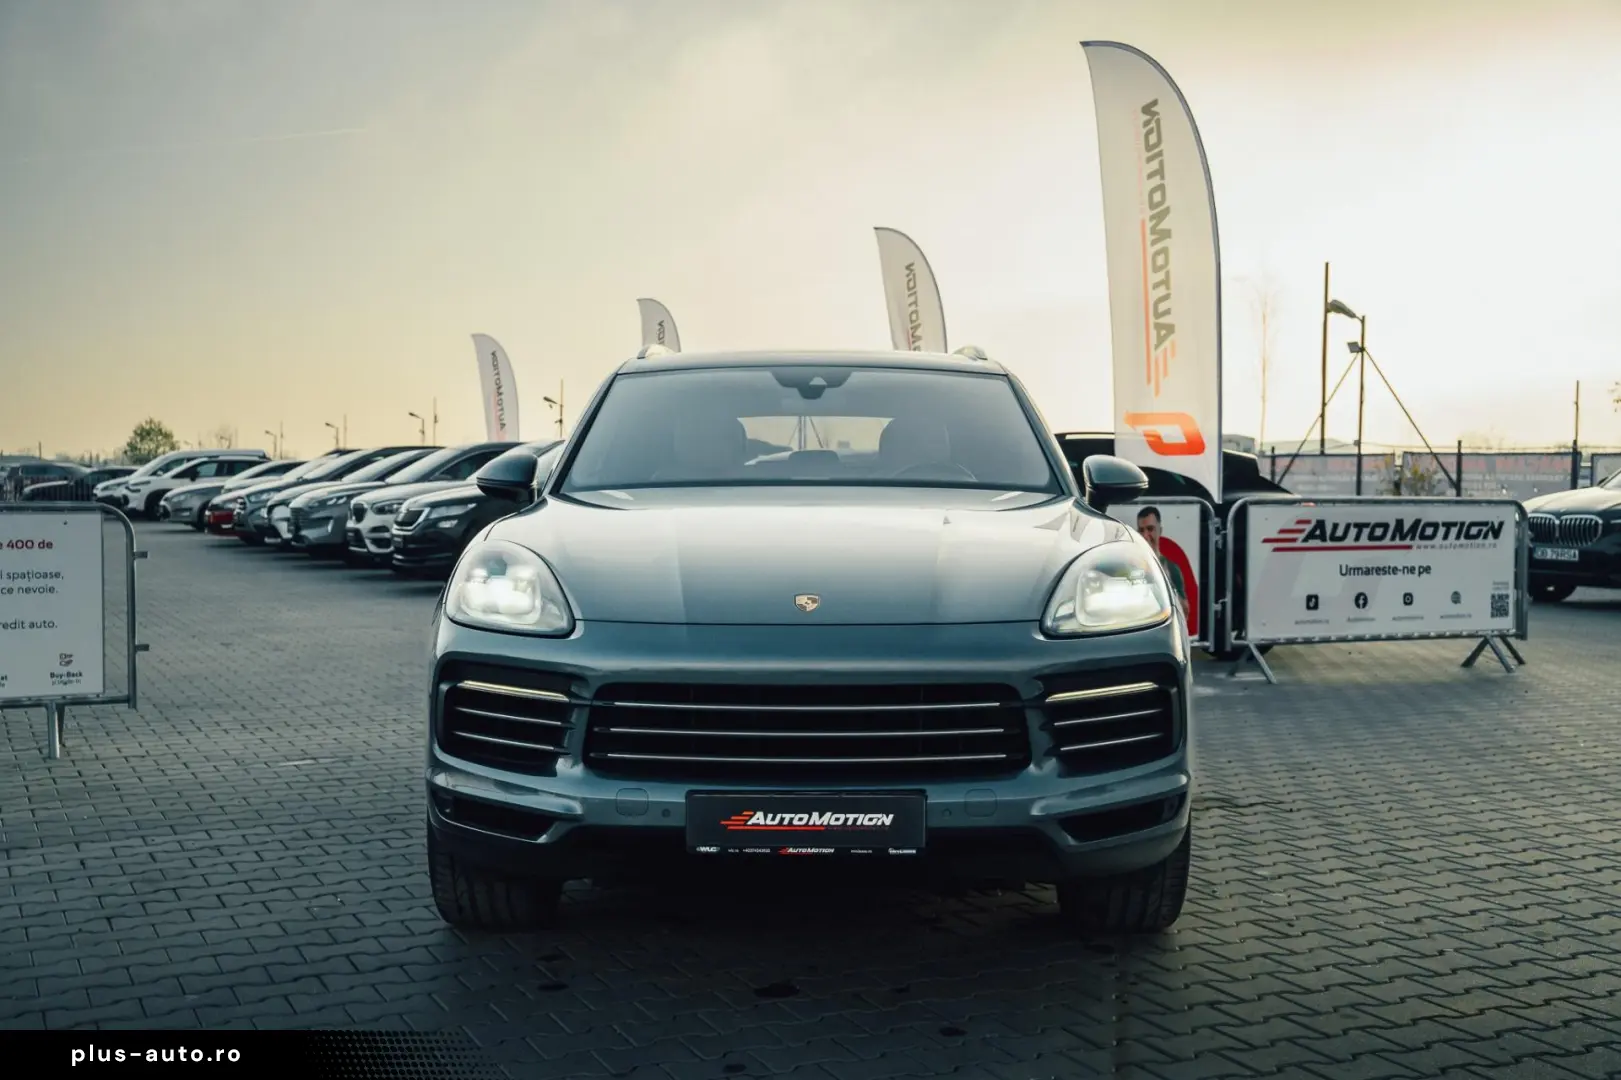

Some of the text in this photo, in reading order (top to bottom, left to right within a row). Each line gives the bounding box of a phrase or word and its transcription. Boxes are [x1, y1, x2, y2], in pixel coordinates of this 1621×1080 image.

[7, 540, 34, 549] 400
[38, 540, 53, 549] de
[1339, 564, 1432, 577] Urmareste-ne pe
[17, 584, 58, 594] nevoie.
[28, 620, 58, 629] auto.
